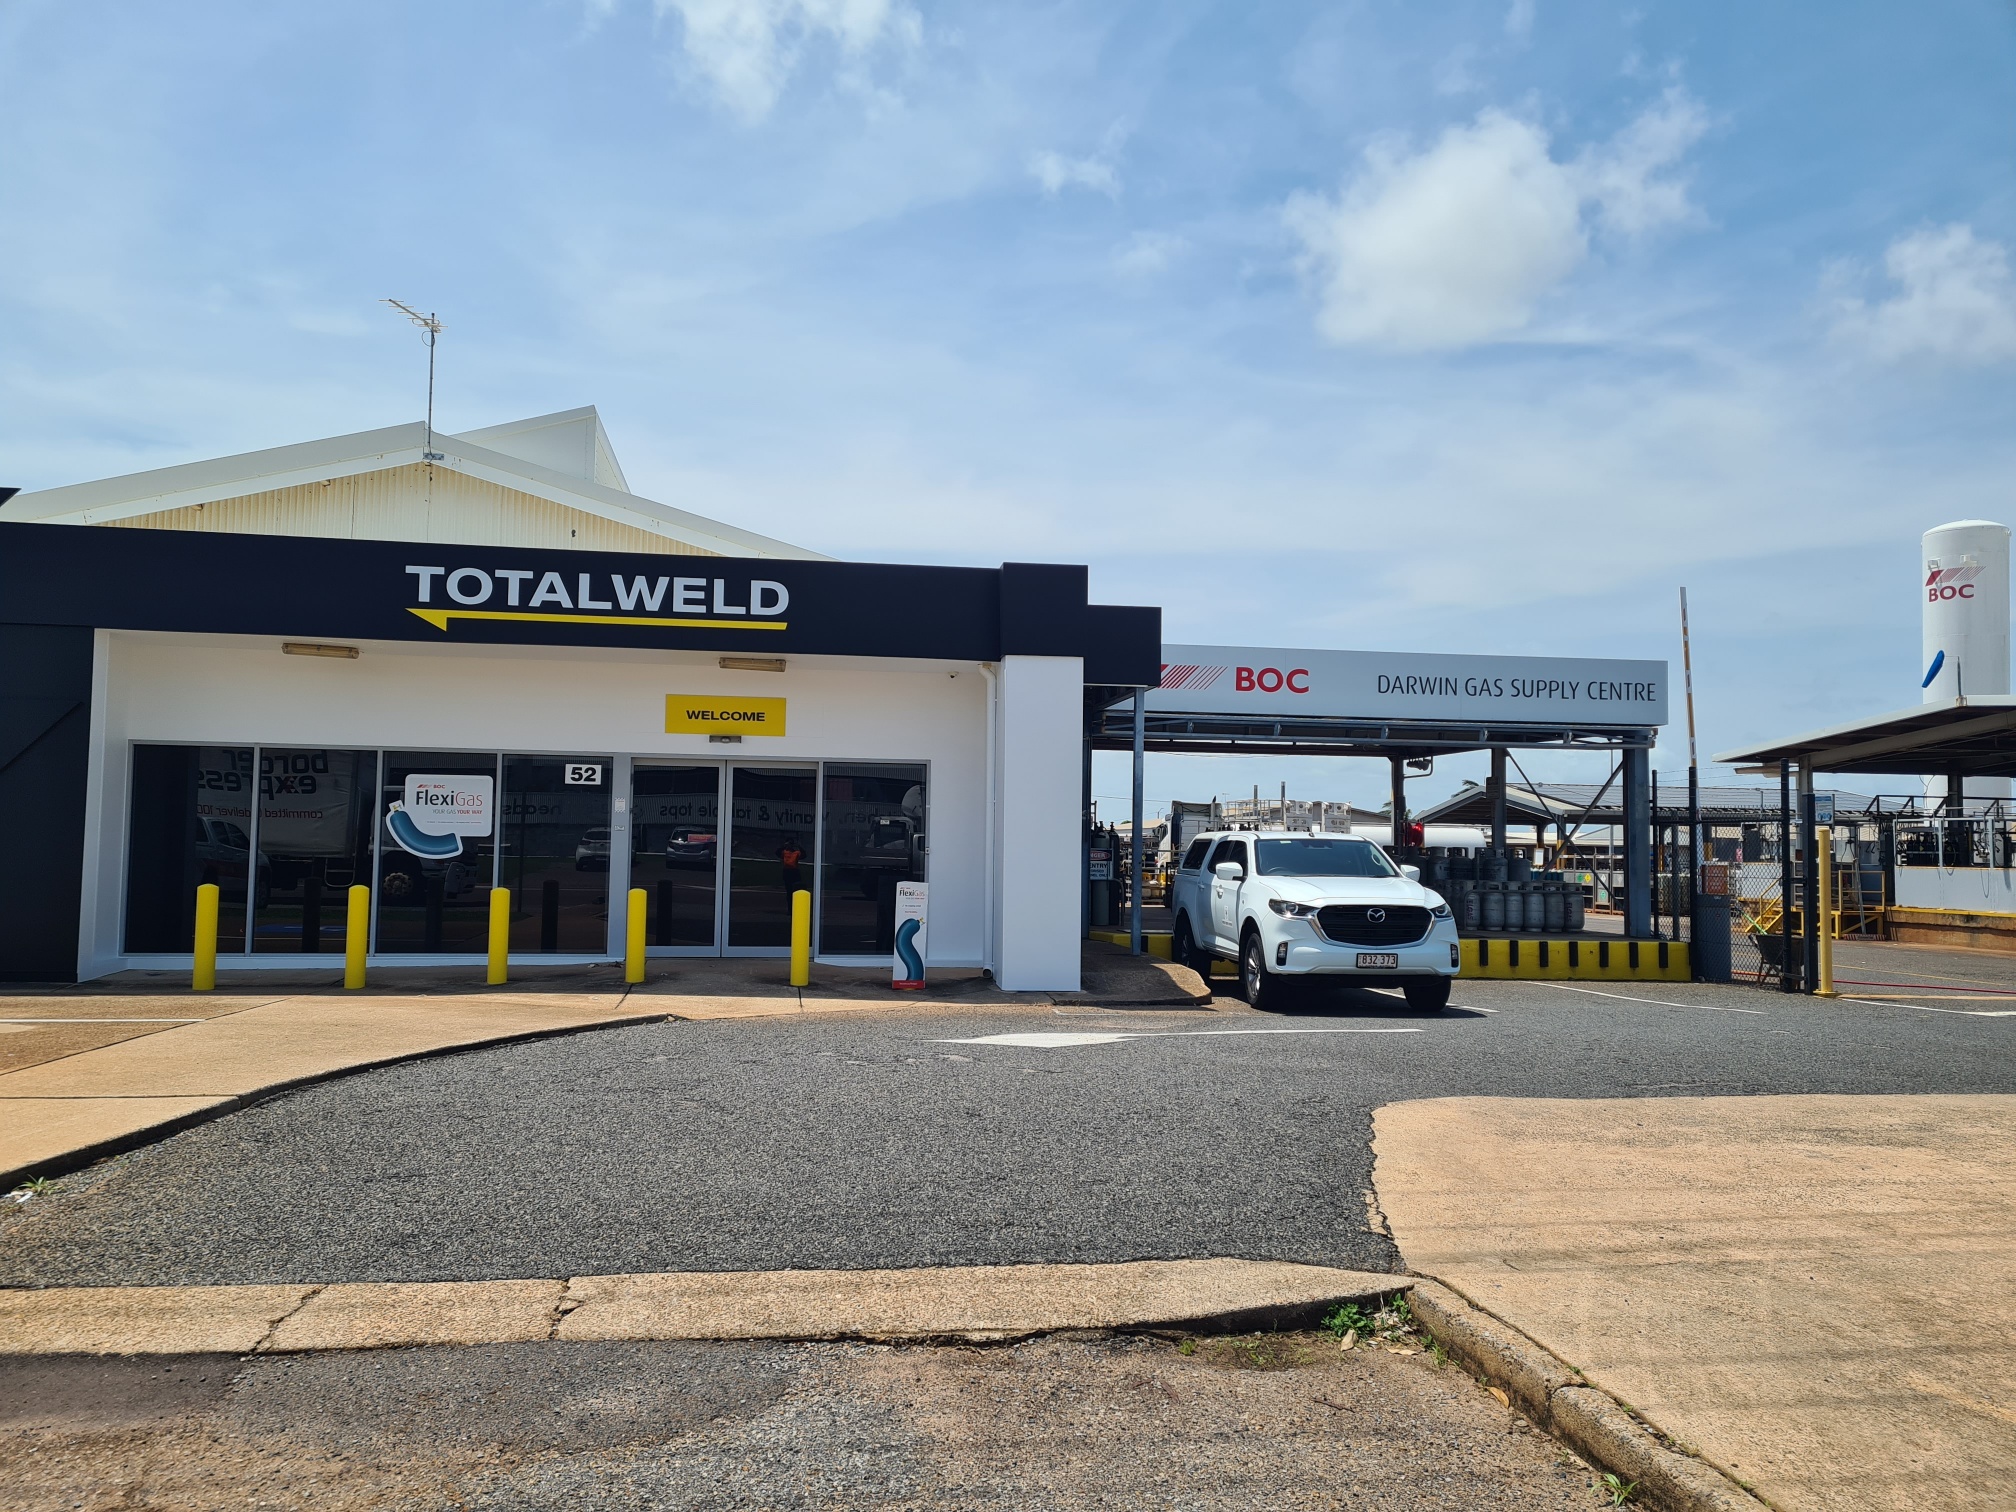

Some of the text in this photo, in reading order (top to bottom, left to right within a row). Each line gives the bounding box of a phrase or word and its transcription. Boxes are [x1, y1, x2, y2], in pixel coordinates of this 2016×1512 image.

[405, 565, 789, 615] TOTALWELD
[1929, 584, 1975, 602] BOC
[1236, 667, 1309, 693] BOC
[1377, 674, 1657, 702] DARWIN GAS SUPPLY CENTRE
[686, 709, 766, 722] WELCOME
[570, 766, 597, 782] 52
[415, 789, 483, 807] FlexiGas
[1362, 955, 1396, 965] 832 373
